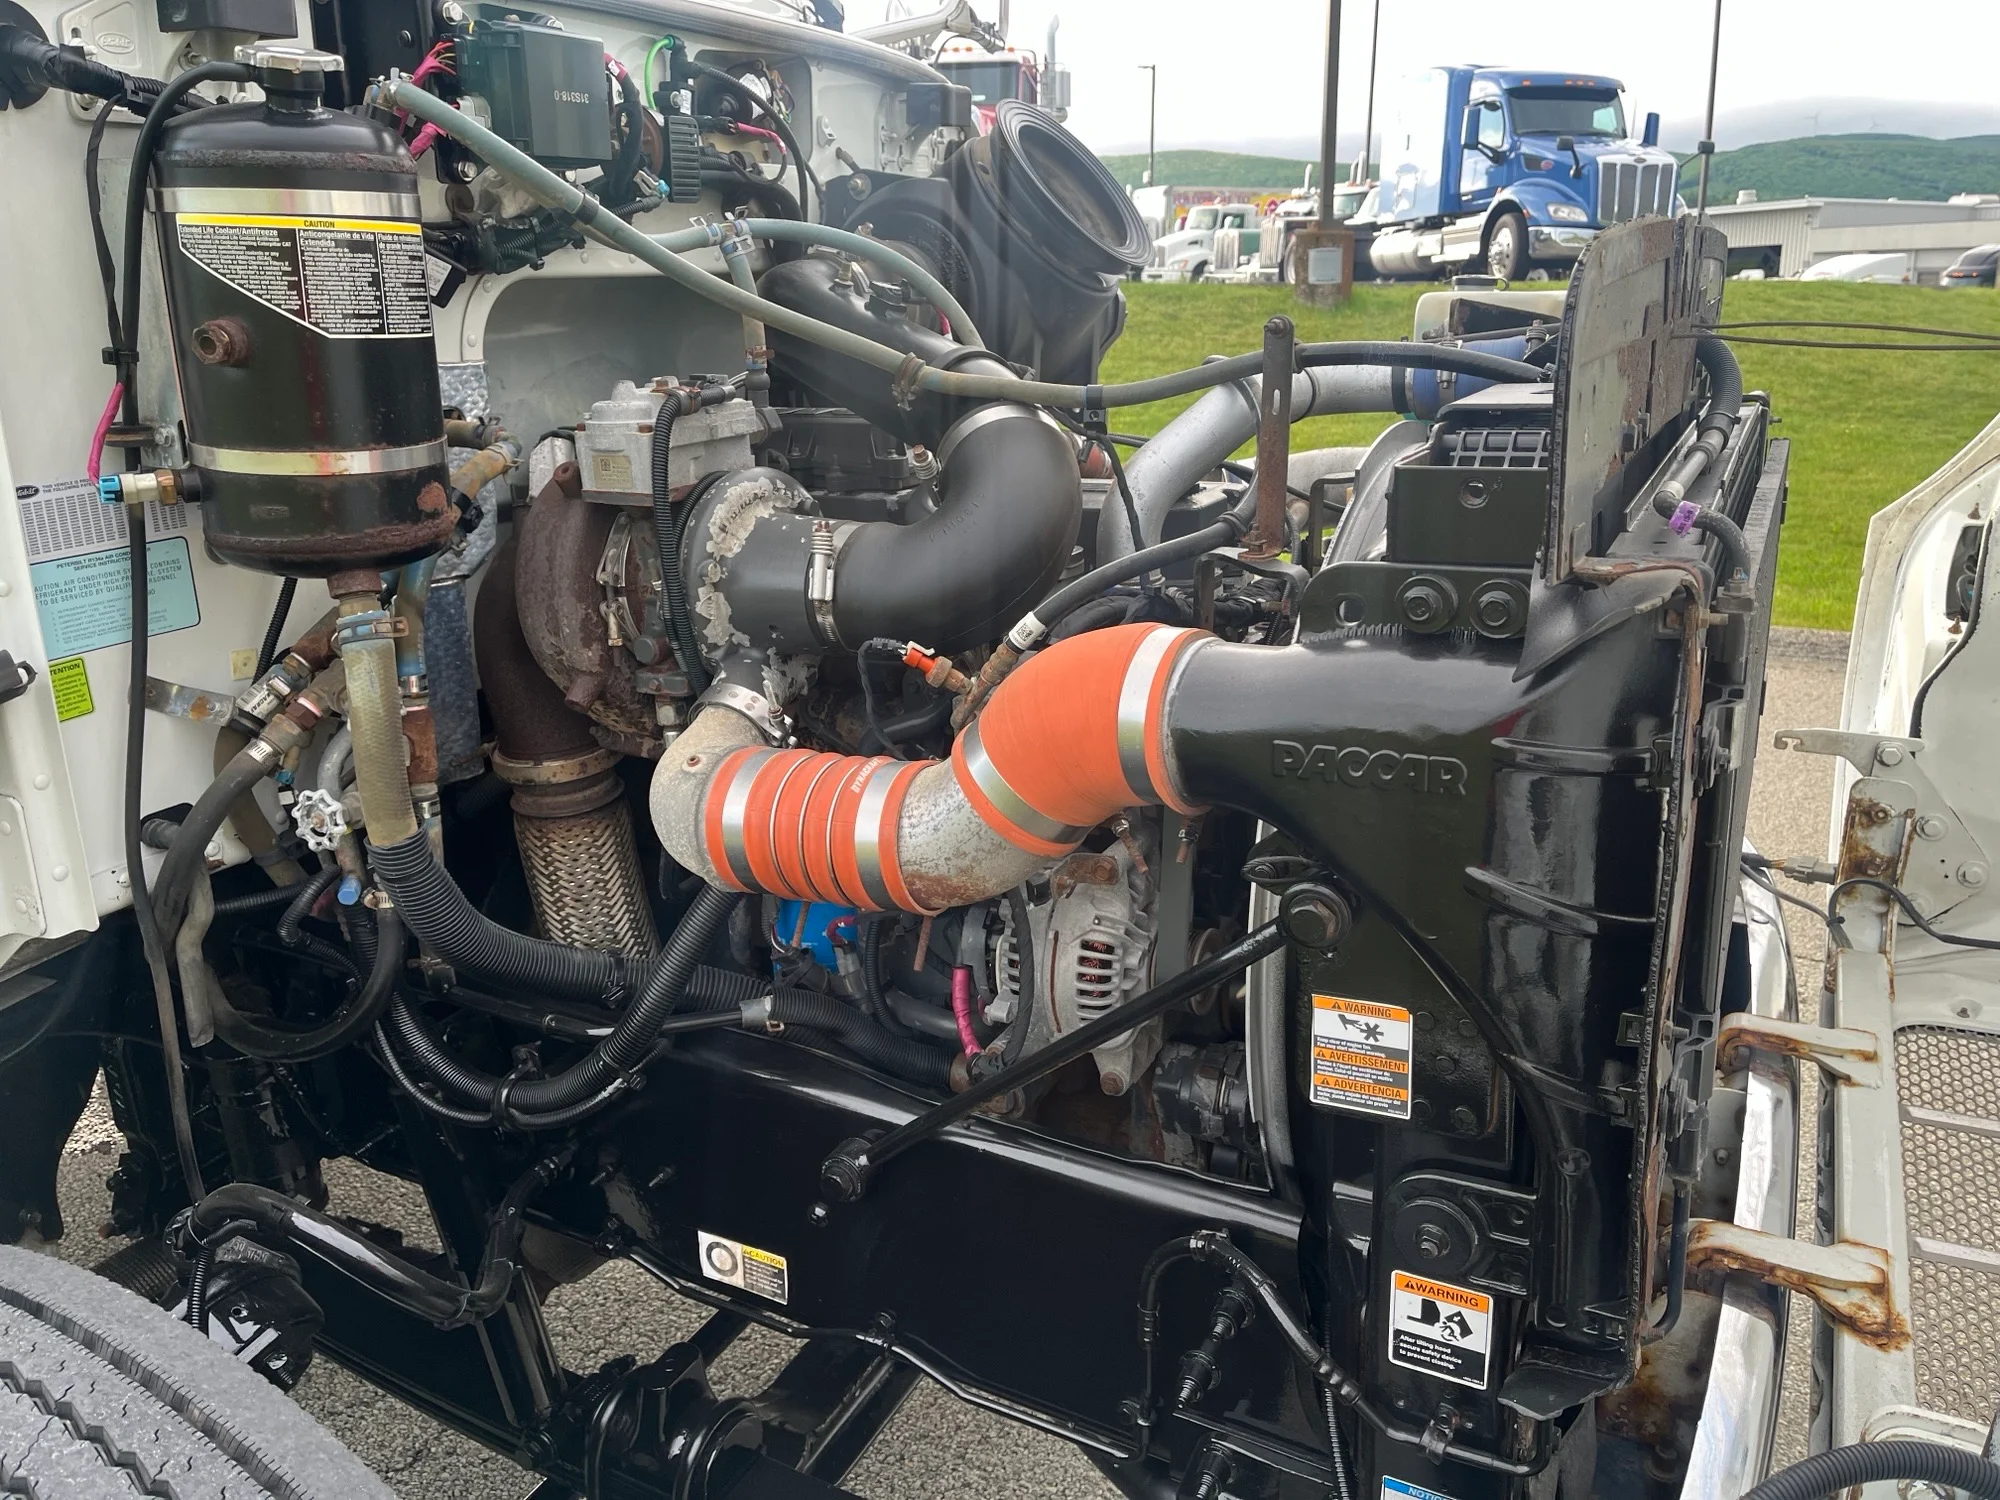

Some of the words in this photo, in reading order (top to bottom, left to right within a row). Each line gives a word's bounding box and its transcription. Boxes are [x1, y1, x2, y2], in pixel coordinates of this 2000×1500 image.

[203, 226, 214, 234] Life
[303, 220, 335, 228] CAUTION
[300, 230, 351, 239] Anticongelante
[360, 232, 374, 240] Vida
[56, 560, 86, 569] PETERBILT
[64, 579, 75, 587] AIR
[77, 569, 122, 583] CONDITIONER
[150, 558, 180, 569] CONTAINS
[74, 563, 97, 571] SERVICE
[35, 586, 77, 600] EFRIGERANT
[80, 580, 101, 591] UNDER
[103, 577, 120, 586] HIGH
[157, 565, 182, 575] SYSTEM
[61, 590, 93, 602] SERVICED
[96, 587, 104, 595] BY
[148, 573, 177, 584] RSONNEL
[50, 663, 80, 675] TENTION
[1272, 739, 1468, 795] PACCAR
[1343, 1002, 1391, 1018] WARNING
[1330, 1051, 1406, 1072] AVERTISSEMENT
[1334, 1079, 1402, 1098] ADVERTENCIA
[749, 1250, 784, 1267] CAUTION
[1415, 1282, 1479, 1308] WARNING
[1400, 1334, 1415, 1343] After
[1416, 1339, 1434, 1350] tilting
[1434, 1345, 1451, 1354] hood
[1400, 1342, 1421, 1352] secure
[1421, 1348, 1440, 1358] safety
[1441, 1353, 1462, 1364] device
[1407, 1351, 1431, 1362] prevent
[1431, 1358, 1455, 1370] closing.
[1408, 1486, 1447, 1500] NOTIC
